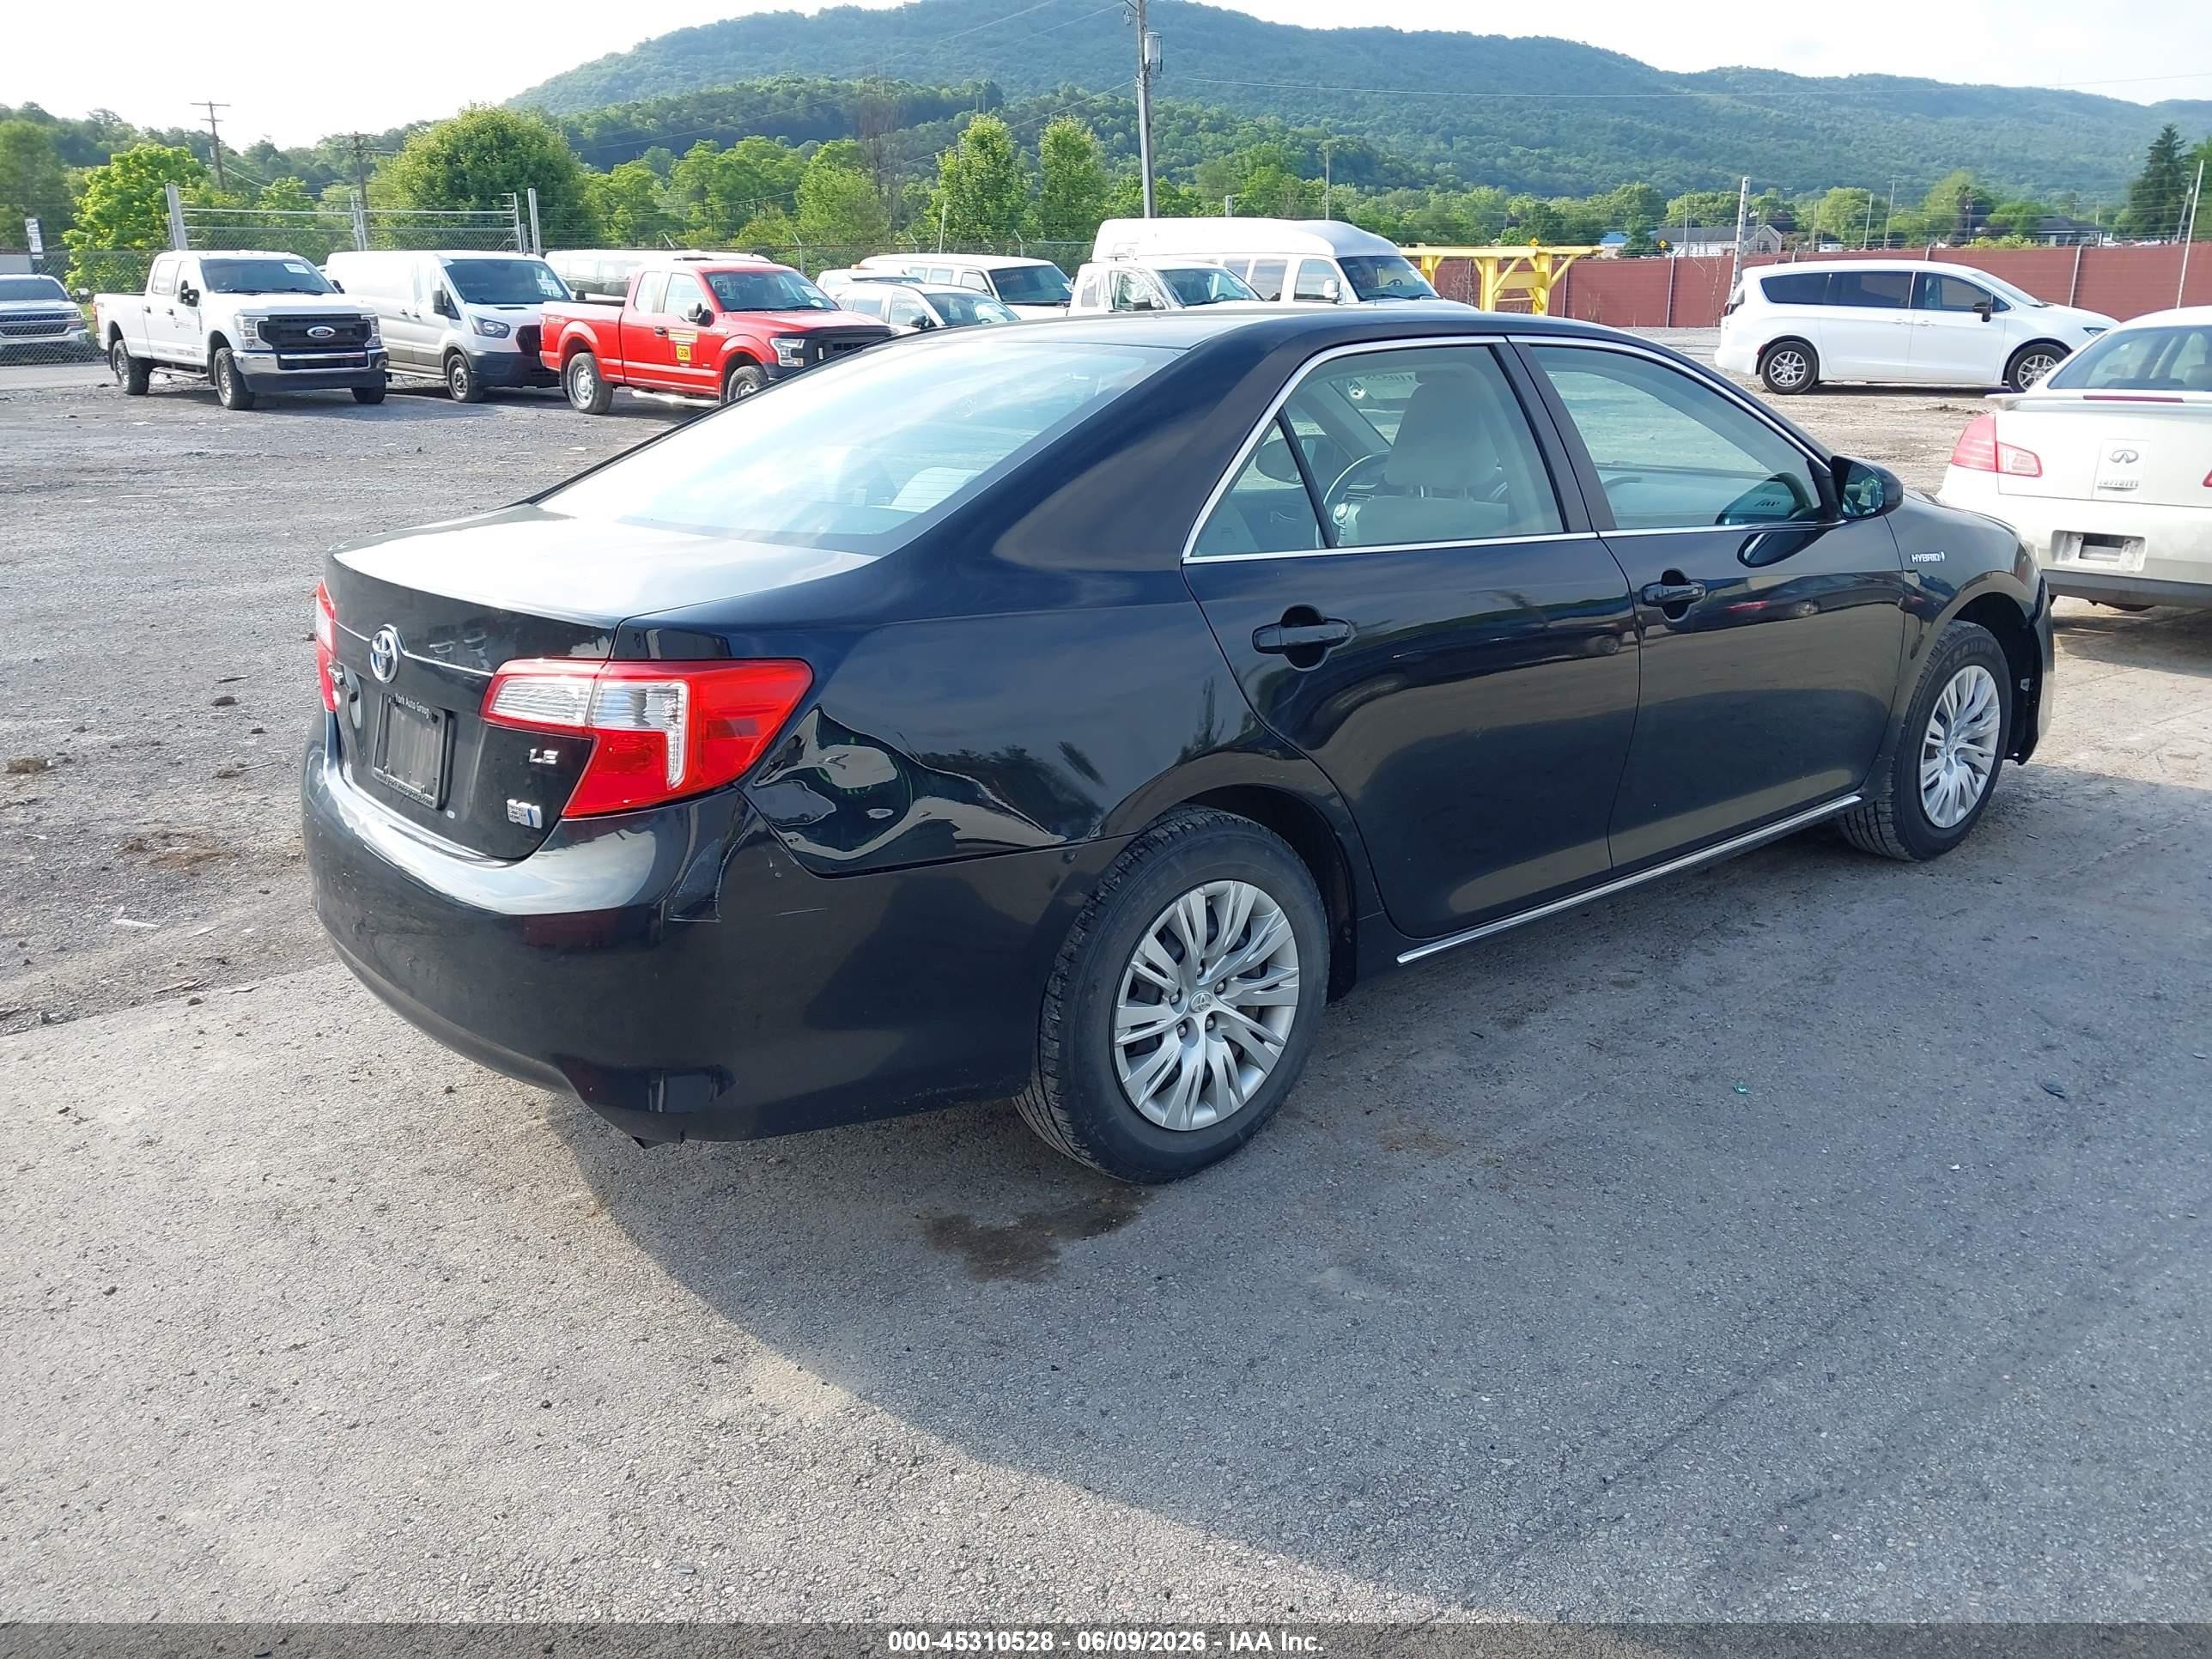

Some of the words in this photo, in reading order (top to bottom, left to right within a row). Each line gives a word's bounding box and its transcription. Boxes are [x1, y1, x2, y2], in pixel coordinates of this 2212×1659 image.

[1911, 552, 1941, 562] HYBRID
[395, 693, 405, 705] York
[405, 696, 416, 709] Auto
[416, 701, 431, 720] Group
[529, 748, 559, 765] LE
